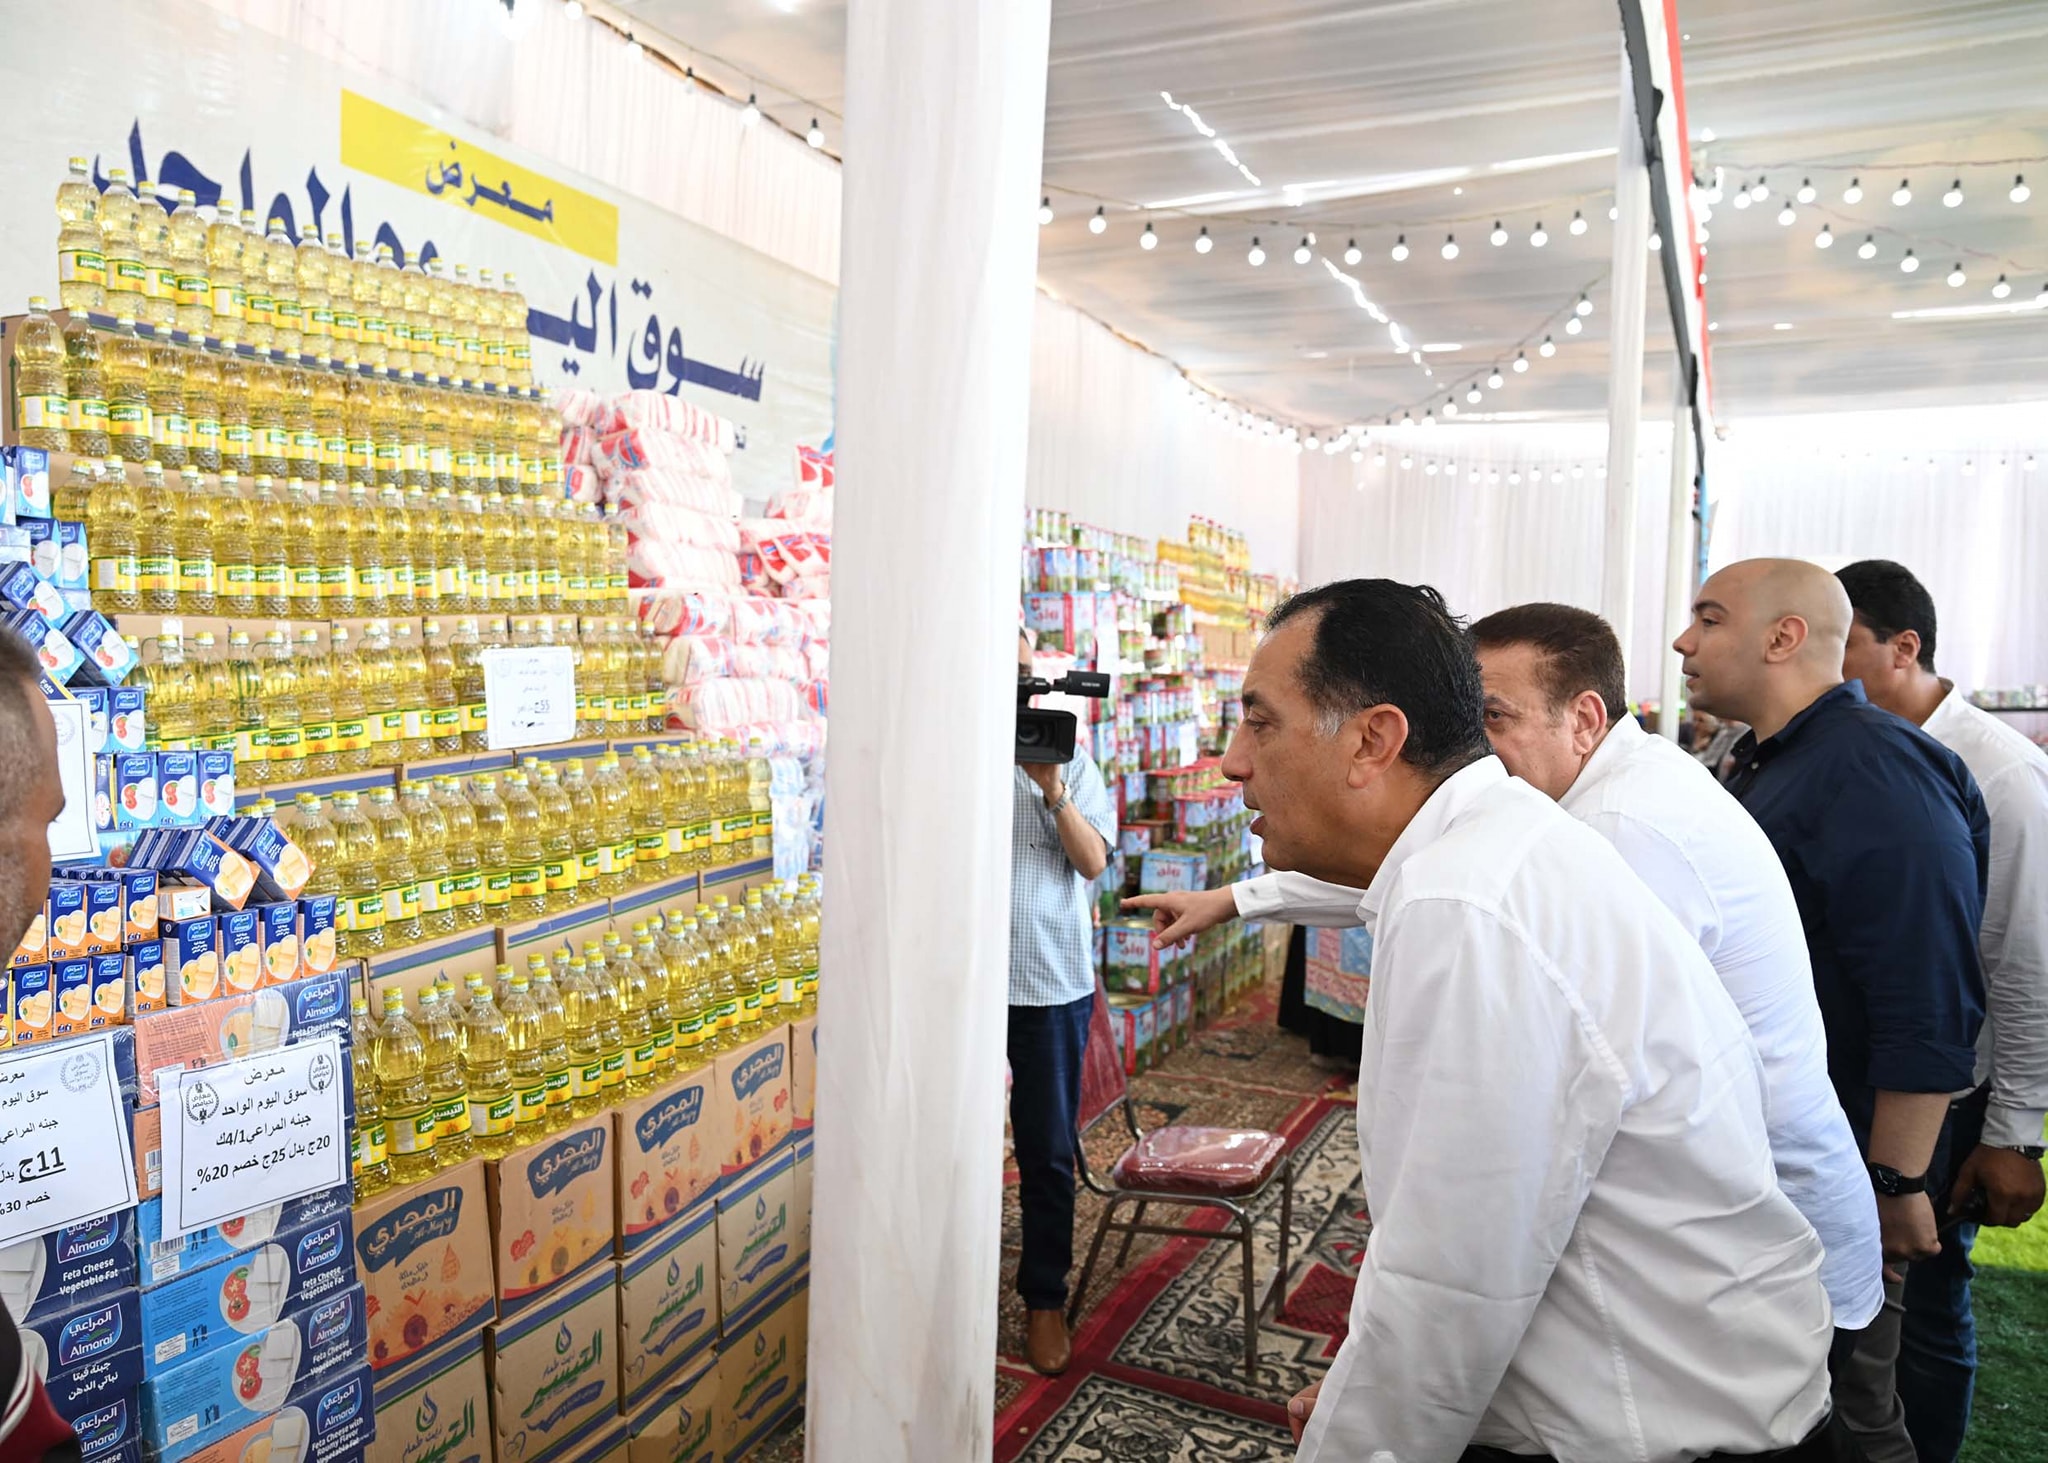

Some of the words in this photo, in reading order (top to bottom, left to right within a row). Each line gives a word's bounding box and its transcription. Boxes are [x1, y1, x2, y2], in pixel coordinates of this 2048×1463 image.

[425, 140, 553, 223] معرض
[627, 277, 765, 402] سوق
[244, 1066, 286, 1086] معرض
[737, 1044, 782, 1090] المجري
[2, 1091, 23, 1110] اليوم
[26, 1089, 48, 1103] سوق
[221, 1097, 254, 1116] الواحد
[257, 1090, 280, 1113] اليوم
[283, 1088, 308, 1105] سوق
[39, 1118, 59, 1130] جبنه
[290, 1113, 312, 1127] جبنه
[641, 1087, 700, 1140] المجري
[288, 1142, 305, 1159] بدل
[307, 1134, 331, 1156] 20ج
[18, 1146, 66, 1184] 11ج
[231, 1154, 260, 1179] خصم
[262, 1147, 286, 1169] 25ج
[535, 1129, 601, 1186] المجري
[25, 1191, 51, 1210] خصم
[366, 1190, 456, 1256] المجري
[67, 1235, 111, 1257] Almarai
[303, 1227, 336, 1250] المراعي
[63, 1269, 81, 1282] Feta
[82, 1258, 115, 1275] Cheese
[305, 1247, 338, 1269] Almarai
[60, 1273, 106, 1296] Vegetable
[105, 1268, 120, 1280] Fat
[300, 1281, 335, 1301] Vegetable
[334, 1275, 345, 1286] Fat
[302, 1277, 317, 1290] Feta
[318, 1266, 342, 1282] Cheese
[69, 1310, 113, 1337] المراعي
[315, 1301, 345, 1324] المراعي
[316, 1319, 348, 1343] Almarai
[69, 1332, 115, 1359] Almarai
[72, 1368, 90, 1382] فيتا
[90, 1360, 112, 1376] جبنة
[520, 1327, 602, 1419] التيسير
[68, 1380, 97, 1401] الدهن
[97, 1371, 119, 1392] نباتي
[324, 1384, 355, 1411] المراعي
[74, 1406, 118, 1434] المراعي
[324, 1403, 356, 1429] Almarai
[80, 1428, 119, 1454] lmarai
[326, 1424, 349, 1441] Cheese
[349, 1417, 364, 1429] with
